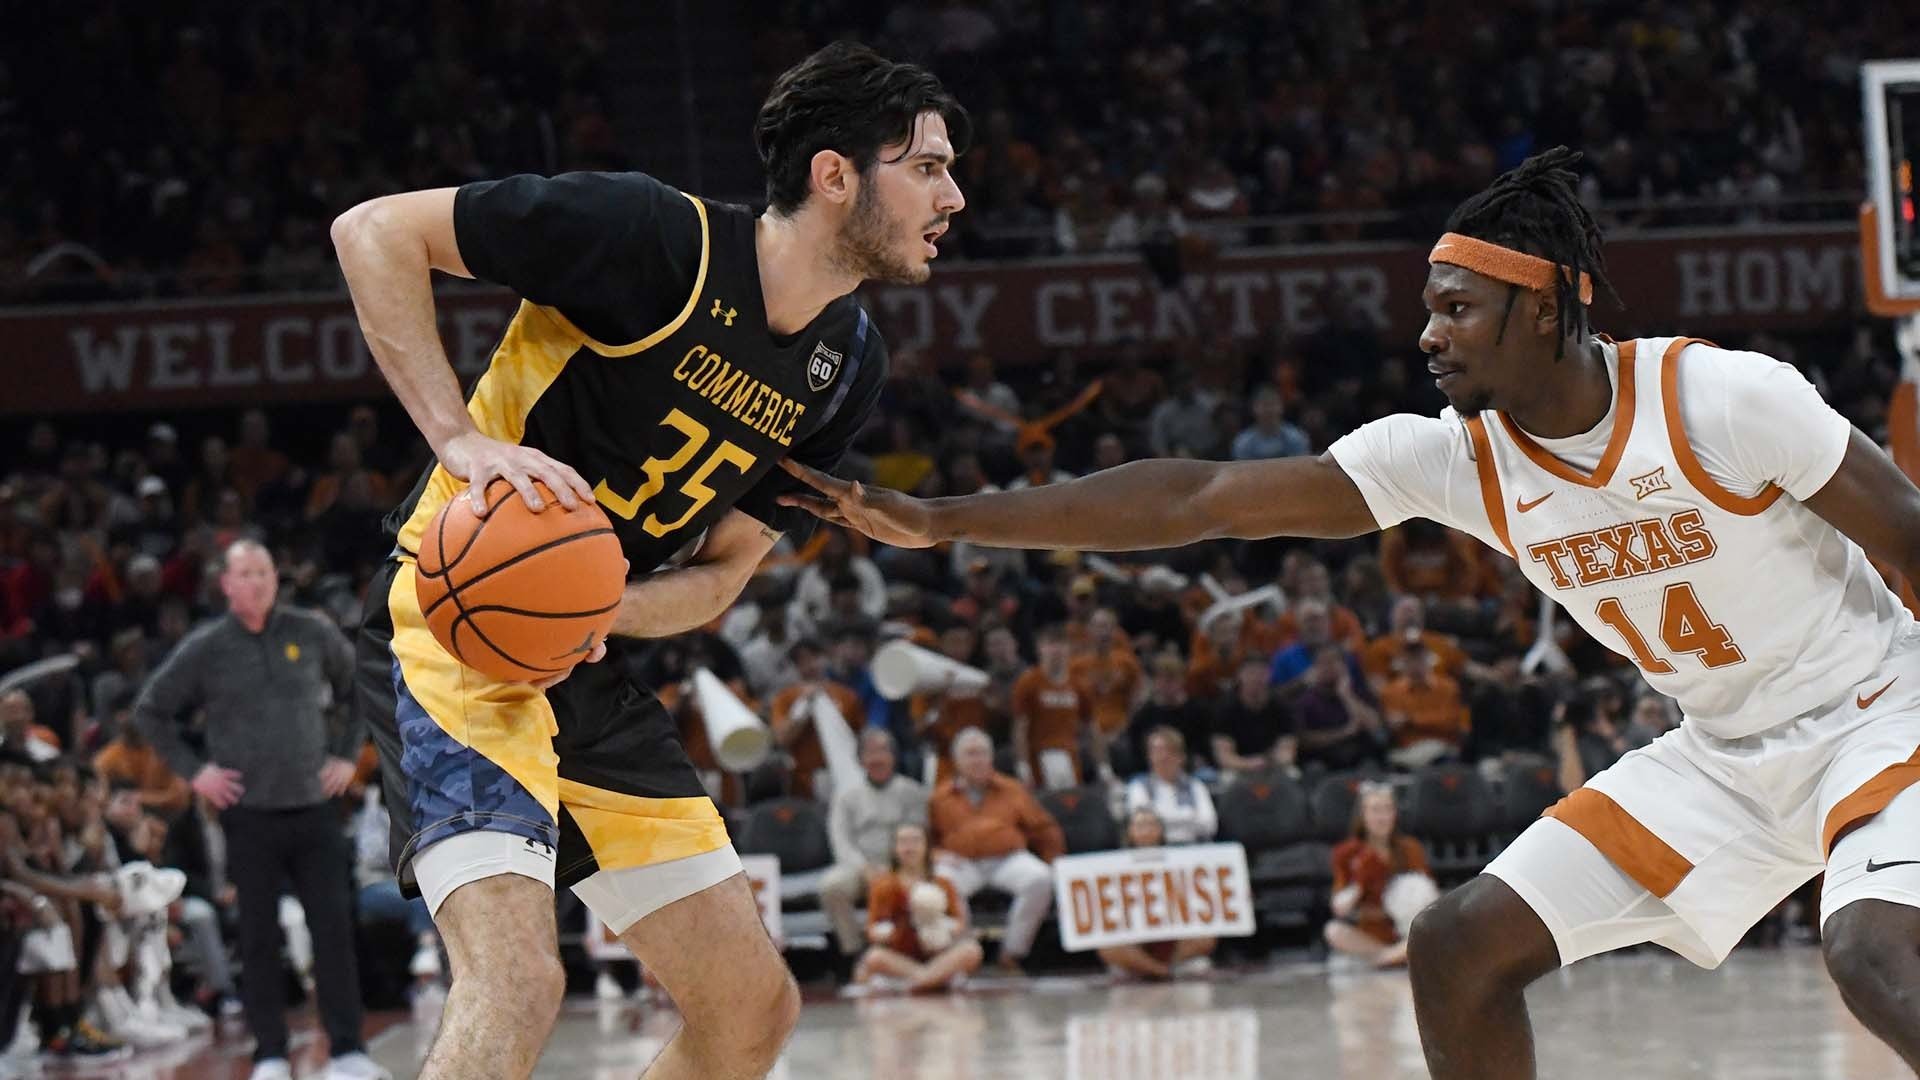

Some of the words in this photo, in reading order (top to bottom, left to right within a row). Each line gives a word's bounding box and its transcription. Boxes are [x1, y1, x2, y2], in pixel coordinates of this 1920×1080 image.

[69, 308, 501, 393] WELCOE
[1036, 264, 1392, 347] CENTER
[811, 357, 832, 380] 60
[672, 344, 806, 447] COMMERCE
[593, 408, 757, 538] 35
[1527, 508, 1717, 590] TEXAS
[1595, 582, 1746, 674] 14
[1069, 866, 1239, 936] DEFENSE
